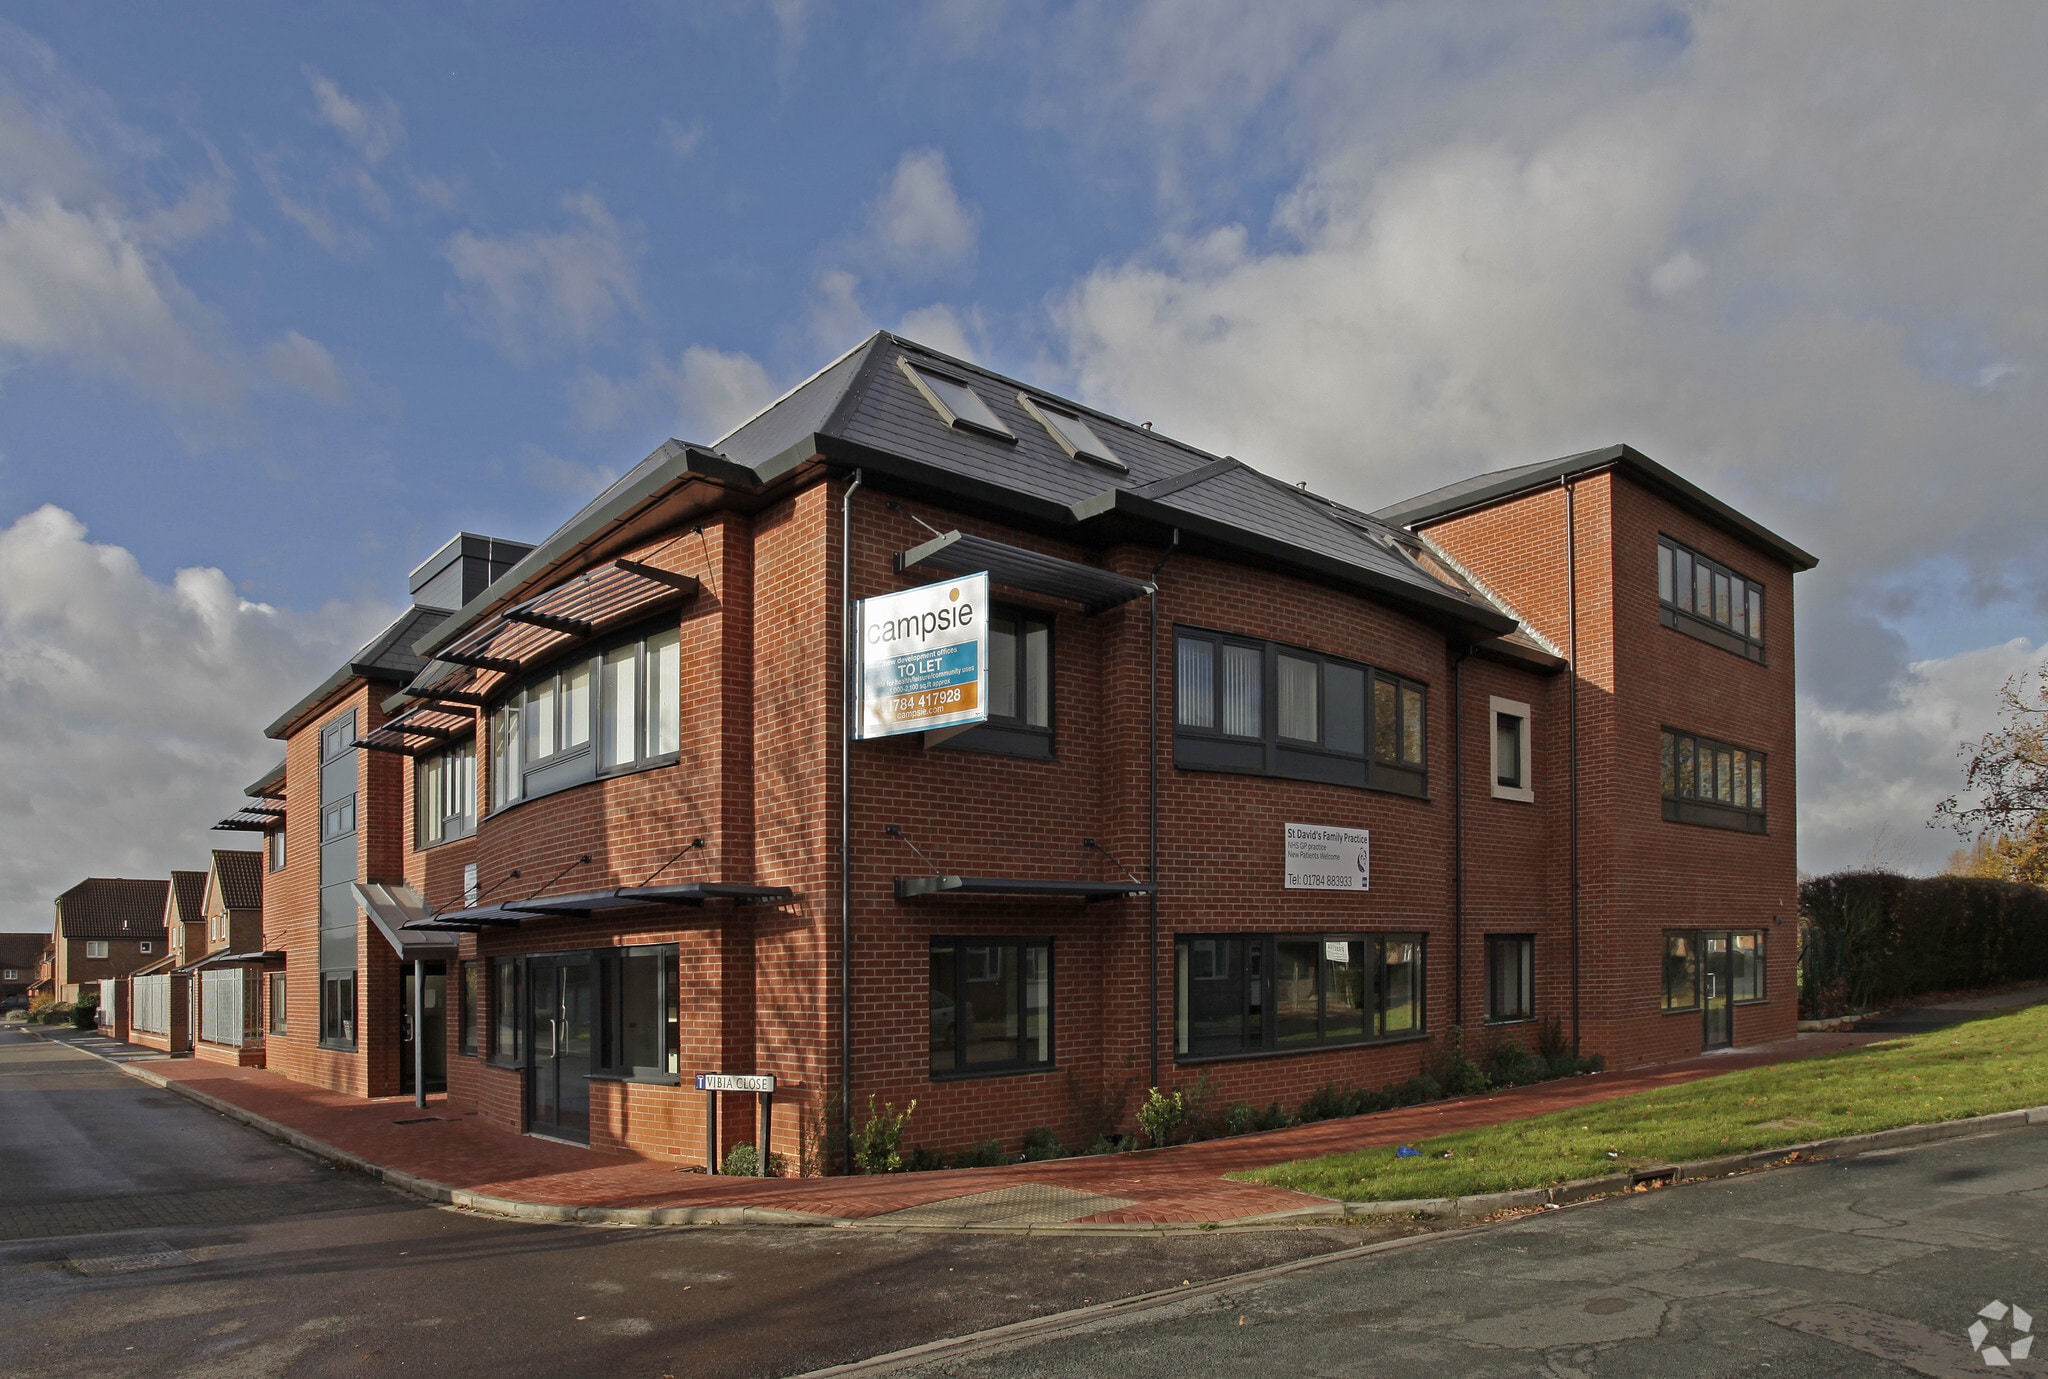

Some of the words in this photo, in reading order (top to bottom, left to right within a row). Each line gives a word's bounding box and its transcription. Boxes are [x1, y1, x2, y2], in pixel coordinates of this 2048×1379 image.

[868, 587, 973, 645] campsie
[897, 651, 937, 665] development
[937, 646, 958, 656] offices
[898, 663, 916, 678] TO
[919, 658, 943, 674] LET
[961, 665, 975, 673] uses
[932, 679, 951, 688] approx
[918, 688, 961, 709] 417928
[896, 705, 944, 720] campsie.com
[1287, 828, 1295, 839] St
[1297, 828, 1322, 841] David's
[1323, 831, 1344, 844] Family
[1344, 833, 1368, 845] Practice
[1308, 843, 1327, 851] practice
[1300, 851, 1319, 859] Patients
[1288, 873, 1301, 886] Tel:
[1302, 874, 1325, 887] 01784
[1326, 875, 1353, 888] 883933
[707, 1076, 733, 1089] VIBIA
[736, 1078, 767, 1090] CLOSE
